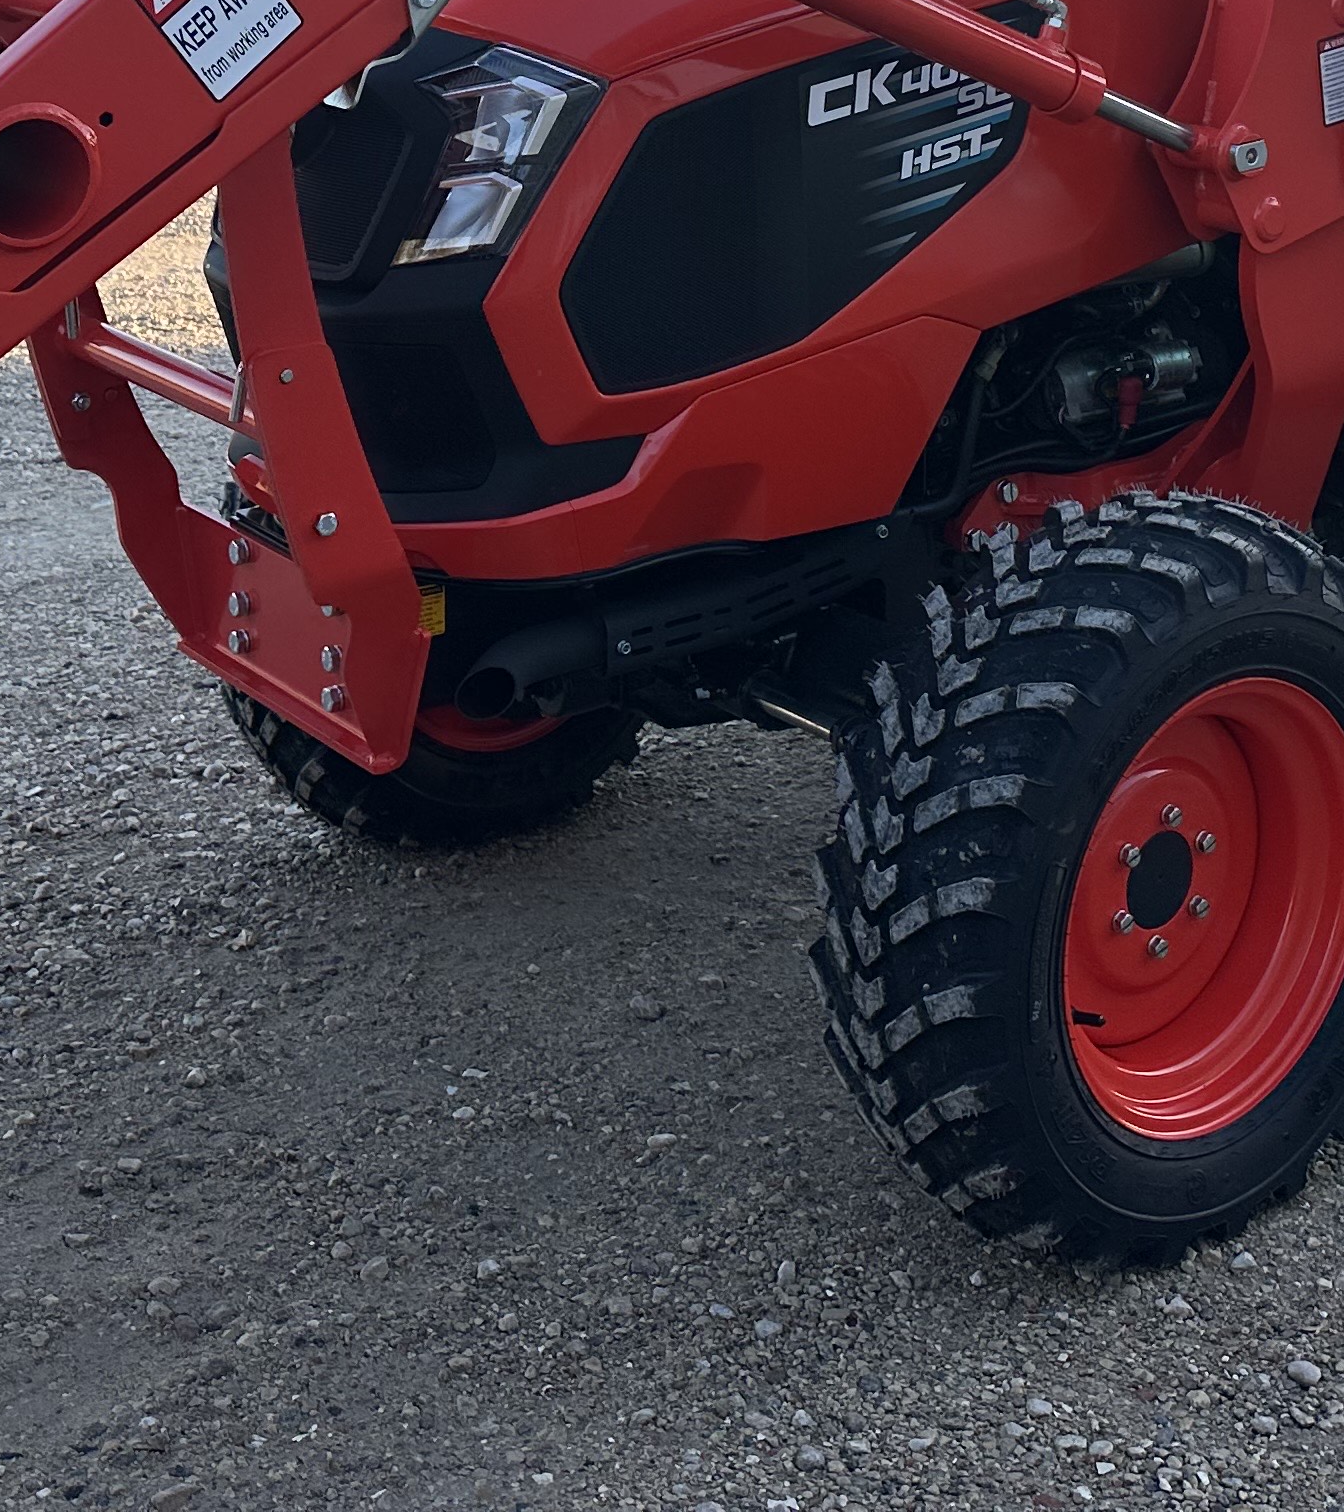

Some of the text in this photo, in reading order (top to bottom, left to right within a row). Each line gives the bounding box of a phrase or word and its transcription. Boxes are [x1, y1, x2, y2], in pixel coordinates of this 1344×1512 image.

[172, 5, 218, 57] KEEP
[201, 1, 289, 84] from working area
[900, 124, 992, 180] HST
